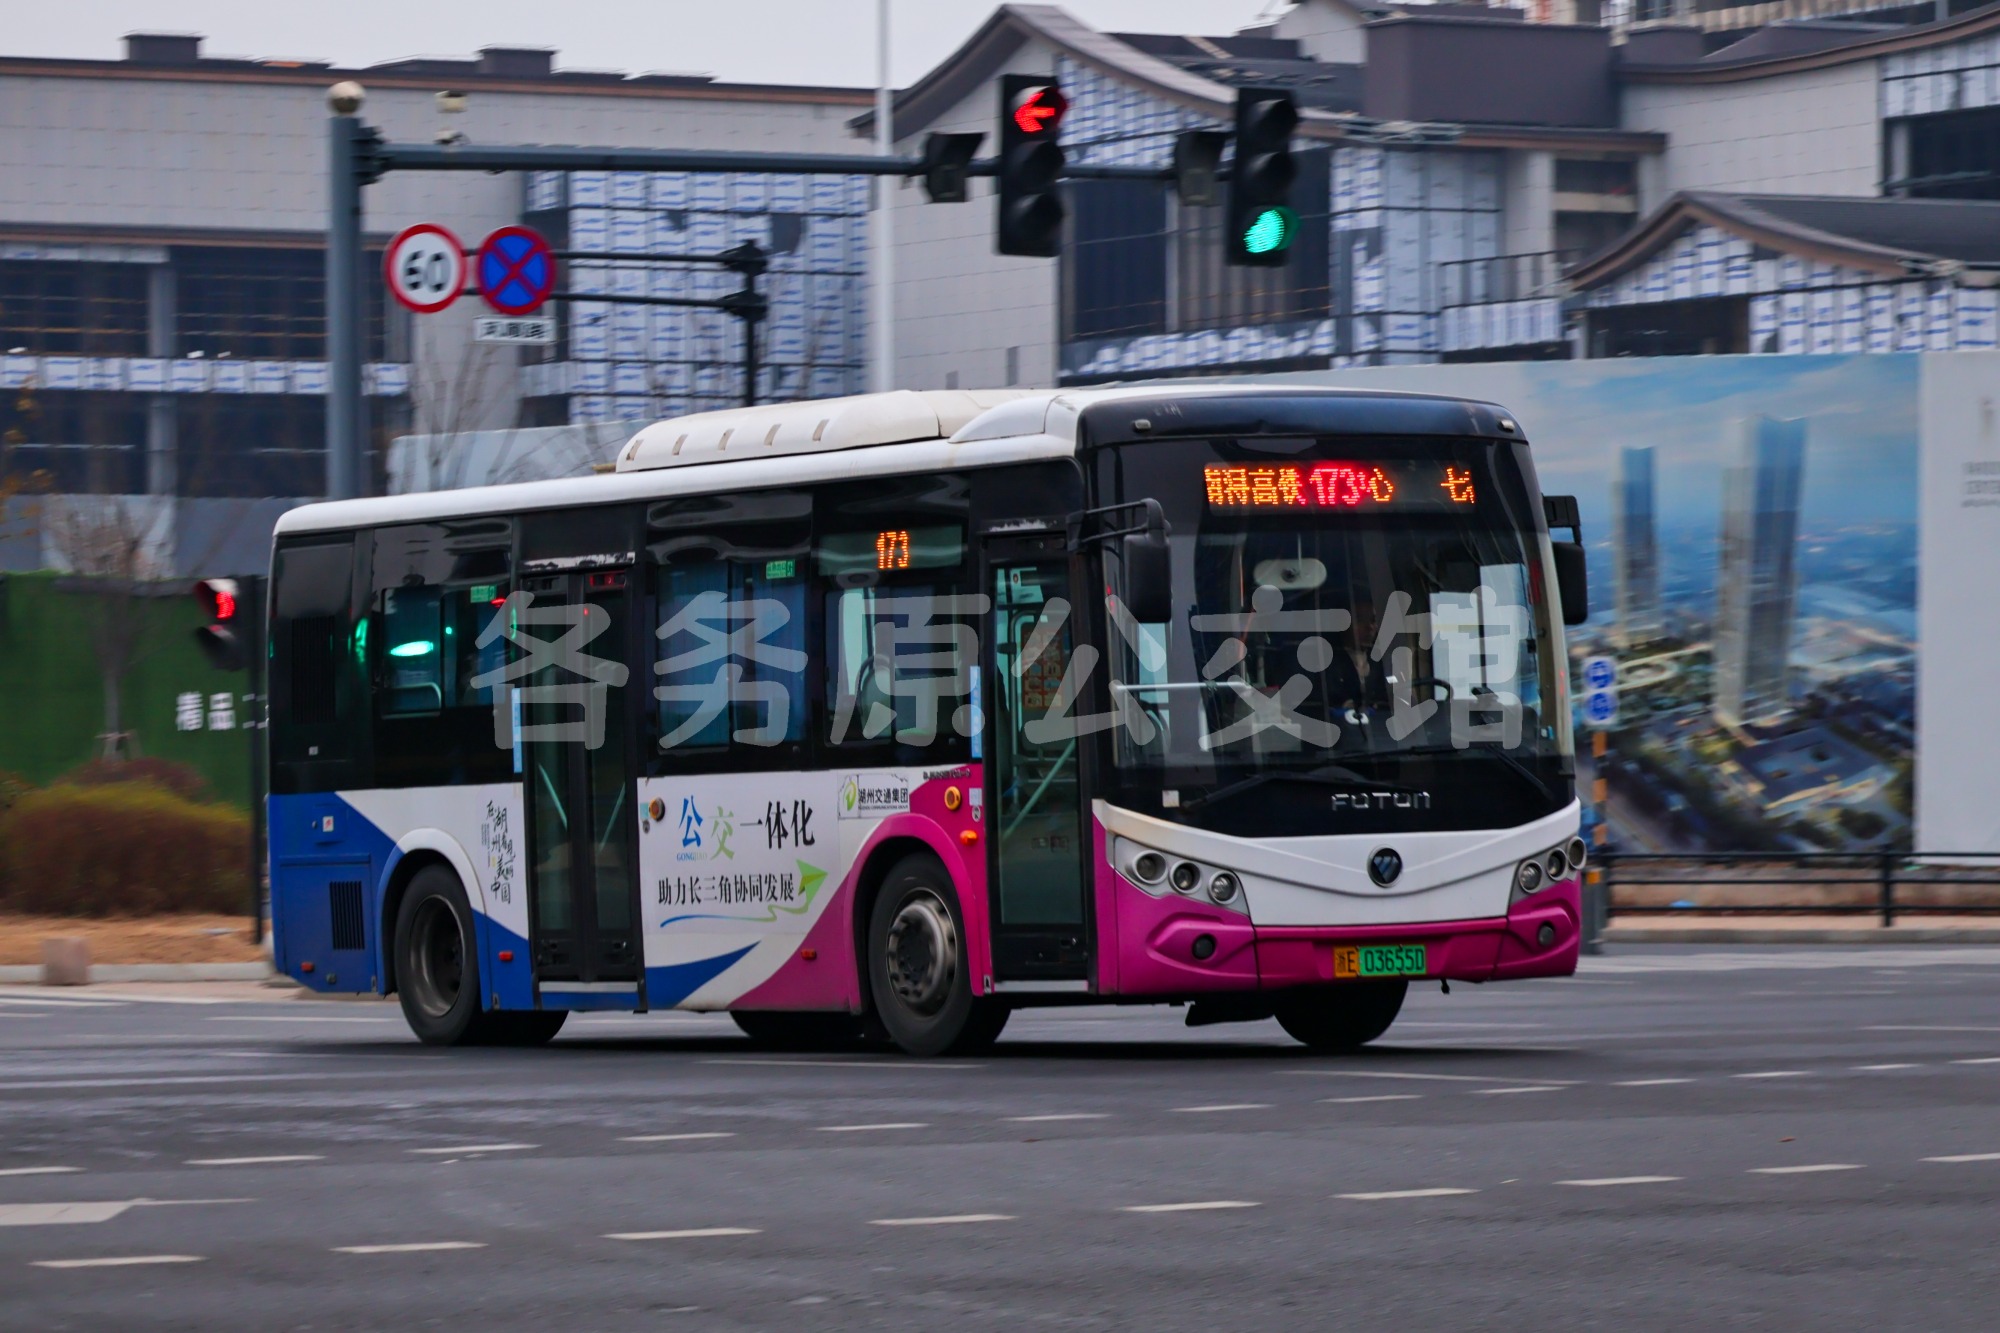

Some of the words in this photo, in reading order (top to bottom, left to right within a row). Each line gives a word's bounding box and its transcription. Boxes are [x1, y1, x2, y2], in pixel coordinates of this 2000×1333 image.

[1309, 468, 1359, 504] 173
[876, 531, 910, 569] 173
[858, 787, 908, 804] 湖州交通集团
[1331, 791, 1431, 811] FOTON
[658, 873, 795, 906] 助力长三角协同发展
